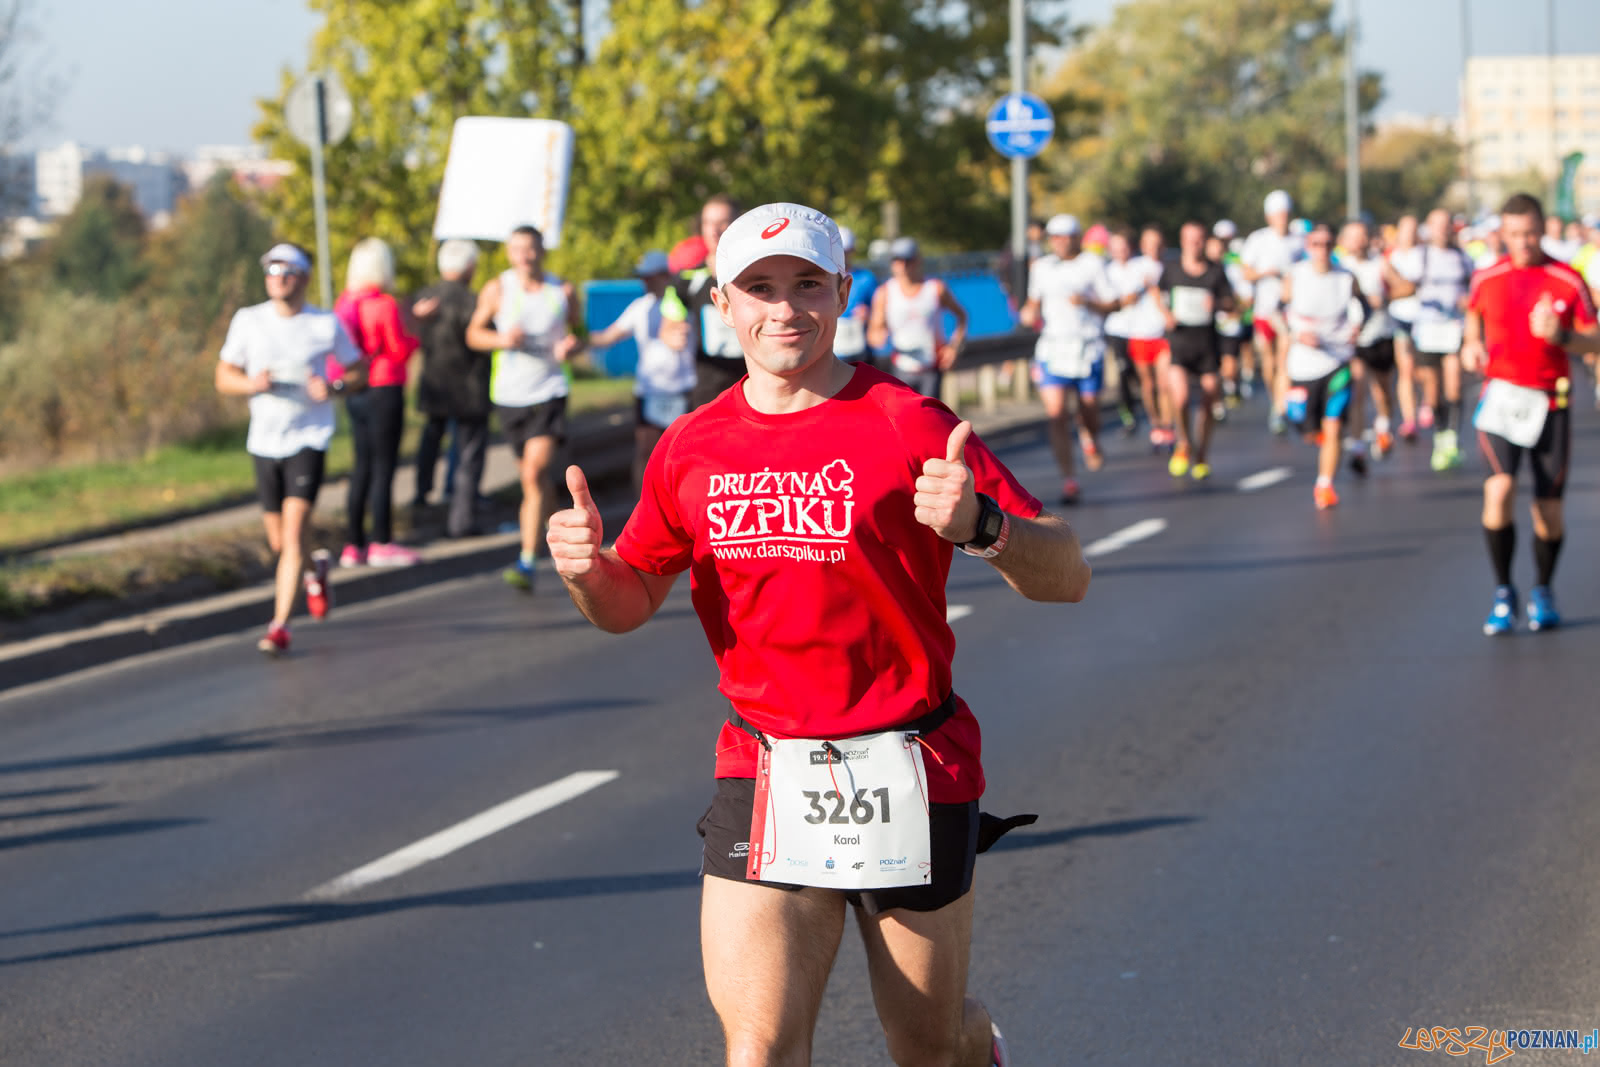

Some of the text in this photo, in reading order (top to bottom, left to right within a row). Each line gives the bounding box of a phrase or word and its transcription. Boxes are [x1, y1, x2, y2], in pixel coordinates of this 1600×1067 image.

[707, 467, 827, 497] DRUŻYNA
[706, 495, 855, 540] SZPIKU
[713, 542, 845, 564] www.darszpiku.pl
[802, 787, 891, 824] 3261
[833, 834, 860, 845] Karol
